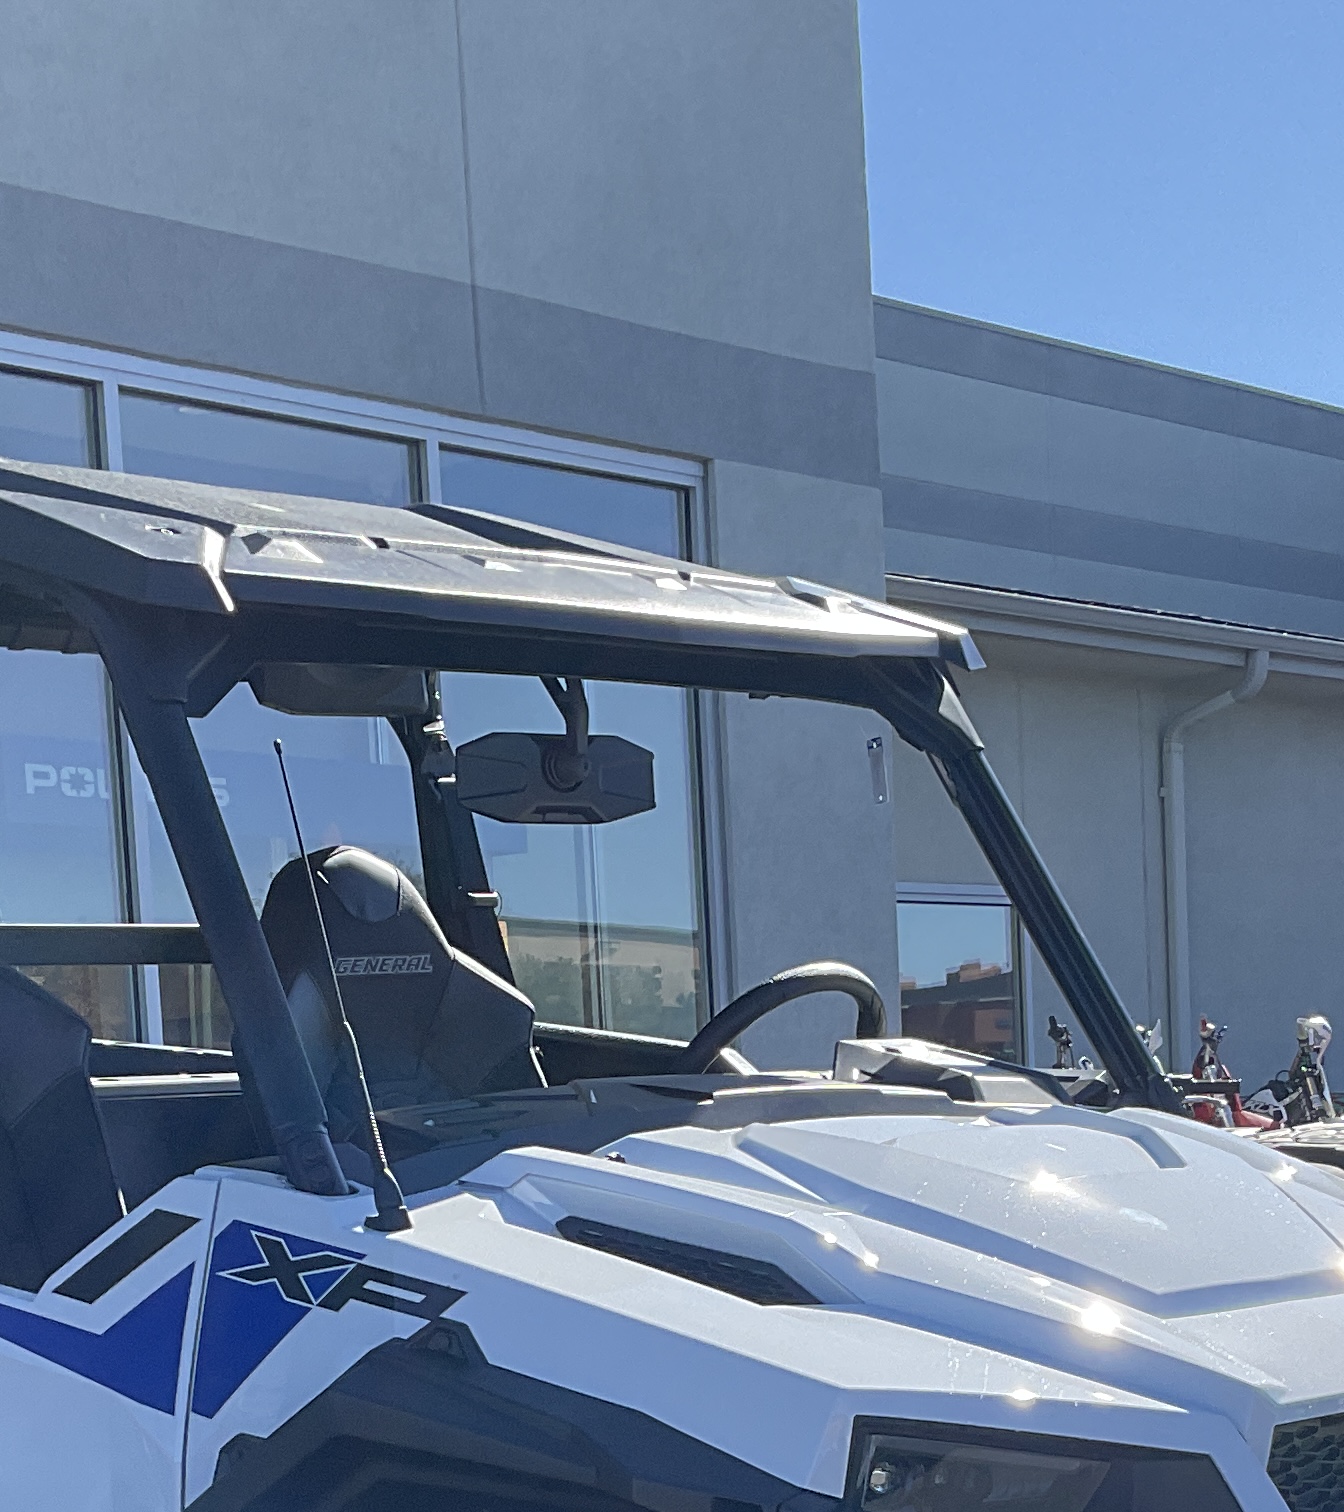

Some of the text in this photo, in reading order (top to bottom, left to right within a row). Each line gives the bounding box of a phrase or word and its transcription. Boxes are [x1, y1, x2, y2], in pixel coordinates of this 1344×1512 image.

[24, 762, 230, 807] POLS
[335, 955, 433, 976] GENERAL
[215, 1229, 468, 1321] XP
